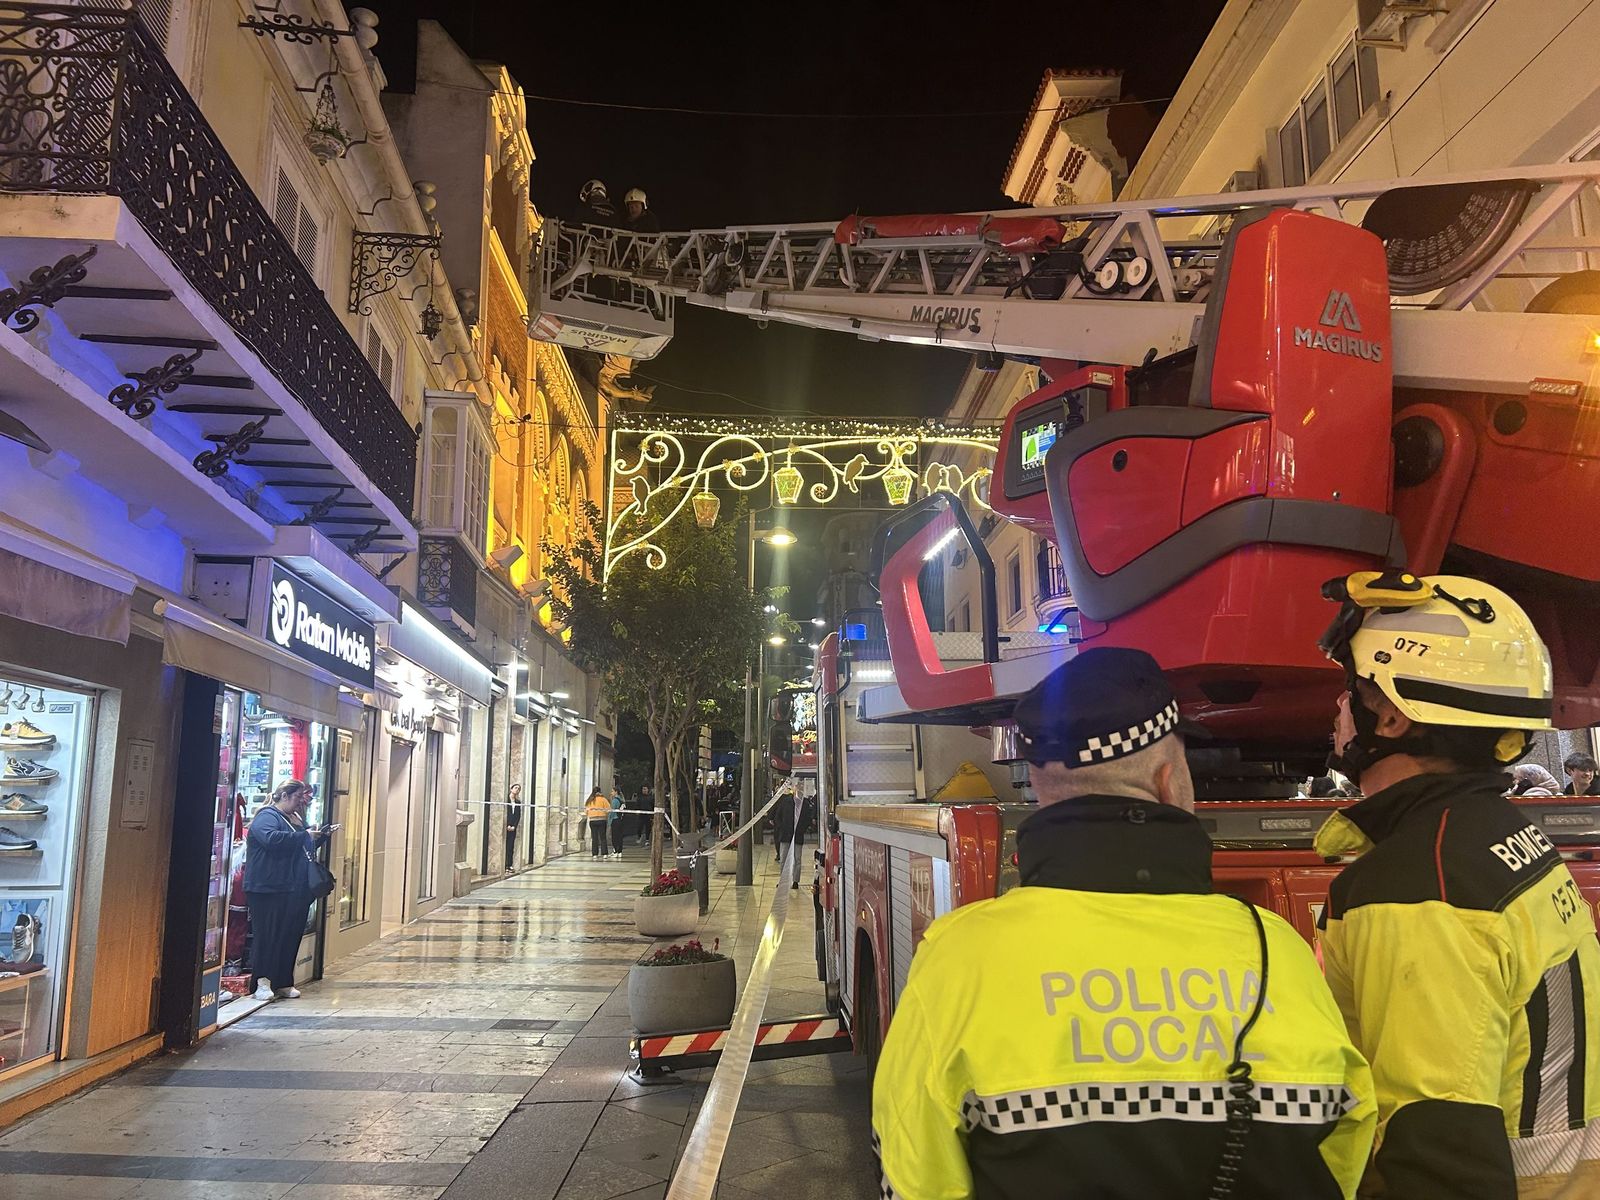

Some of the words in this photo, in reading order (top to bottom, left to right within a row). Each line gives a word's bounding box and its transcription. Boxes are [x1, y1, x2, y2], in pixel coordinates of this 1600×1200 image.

[910, 305, 981, 330] MAGIRUS
[570, 329, 628, 344] MAGIRUS
[1294, 326, 1382, 363] MAGIRUS
[295, 601, 336, 656] Ratan
[335, 622, 371, 671] Mobile
[1394, 637, 1431, 658] 077
[1040, 967, 1275, 1017] POLICIA
[1070, 1014, 1266, 1064] LOCAL
